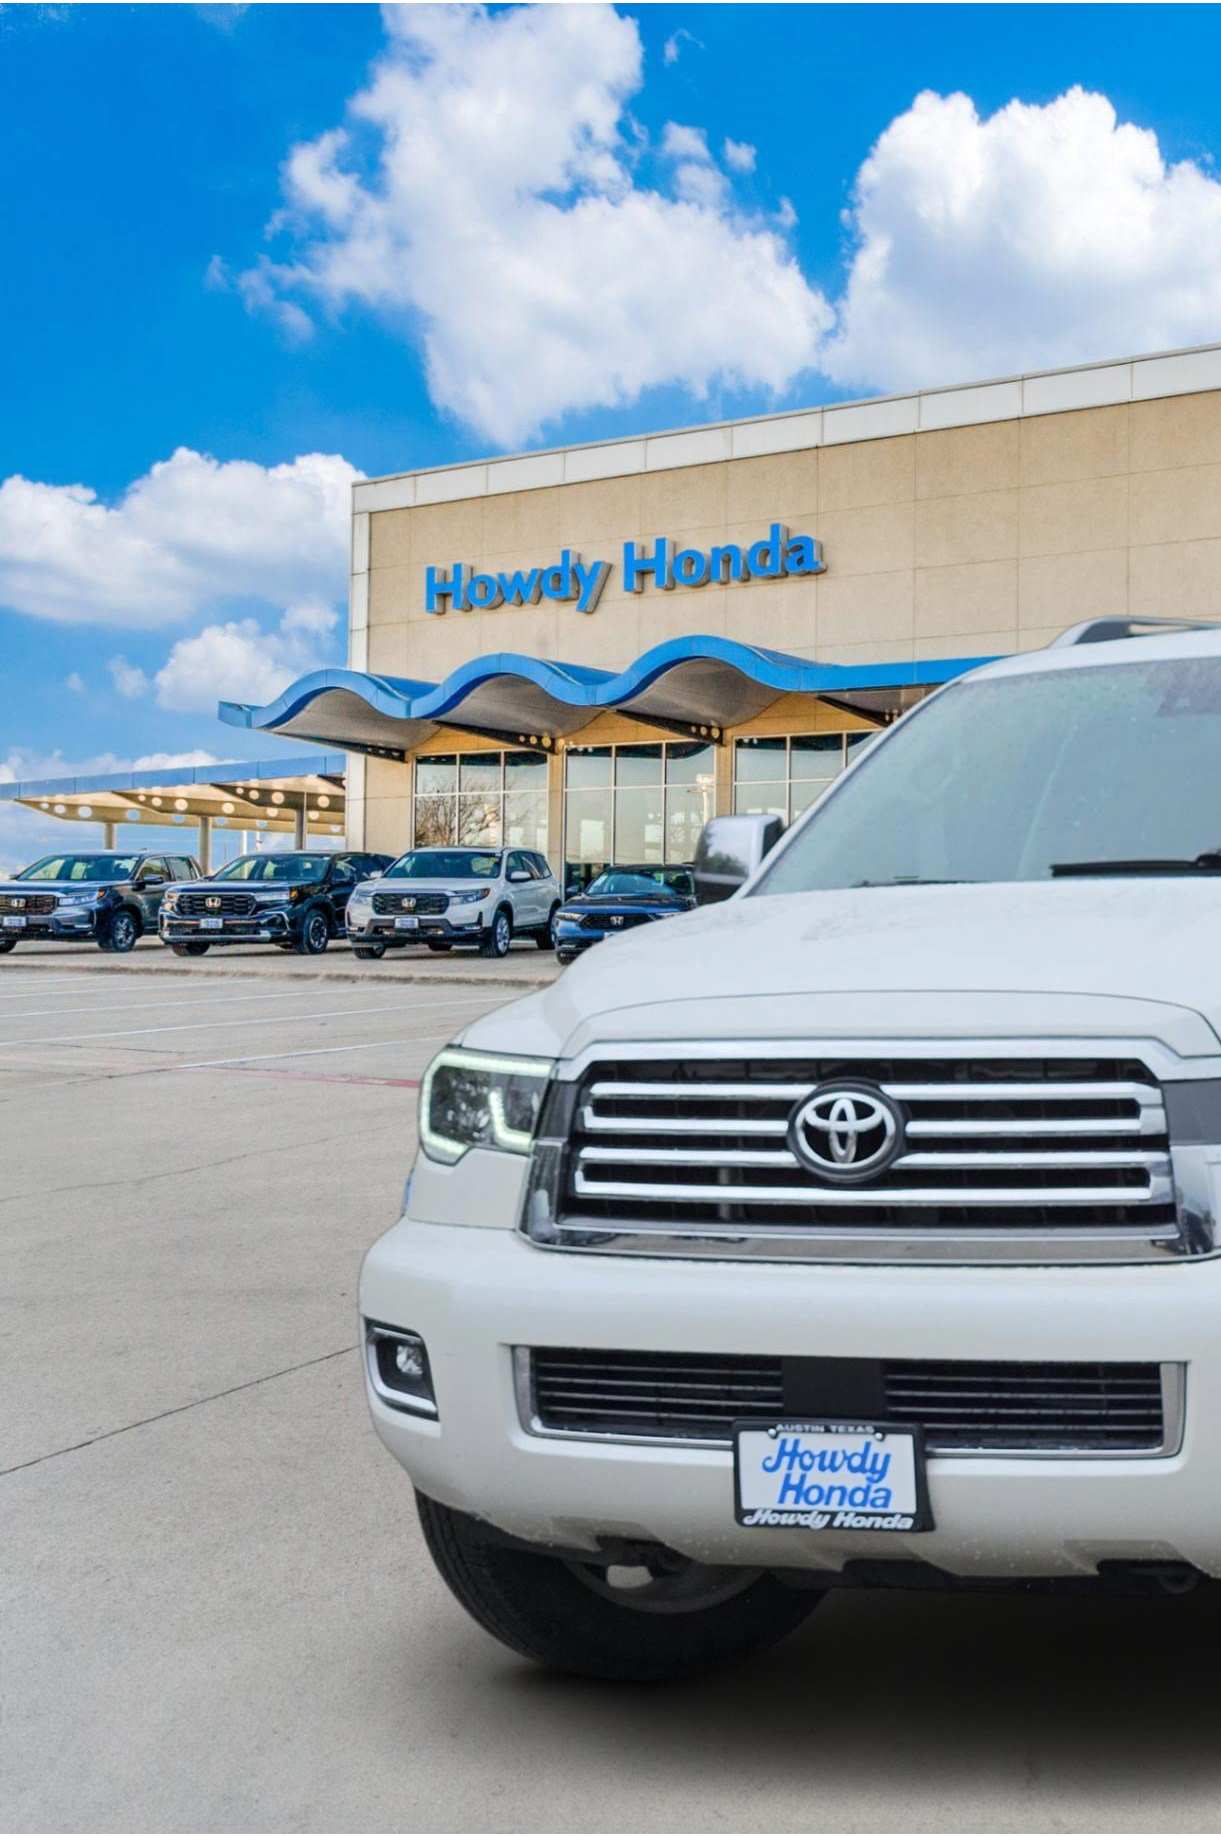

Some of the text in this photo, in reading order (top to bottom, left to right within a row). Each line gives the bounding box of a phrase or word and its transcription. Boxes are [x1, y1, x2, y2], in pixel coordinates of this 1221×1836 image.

[425, 522, 827, 614] Howdy Honda
[775, 1424, 875, 1434] AUSTIN TEXAS
[762, 1438, 891, 1483] Howdy
[777, 1473, 892, 1509] Honda
[743, 1509, 914, 1530] Howdy Honda
